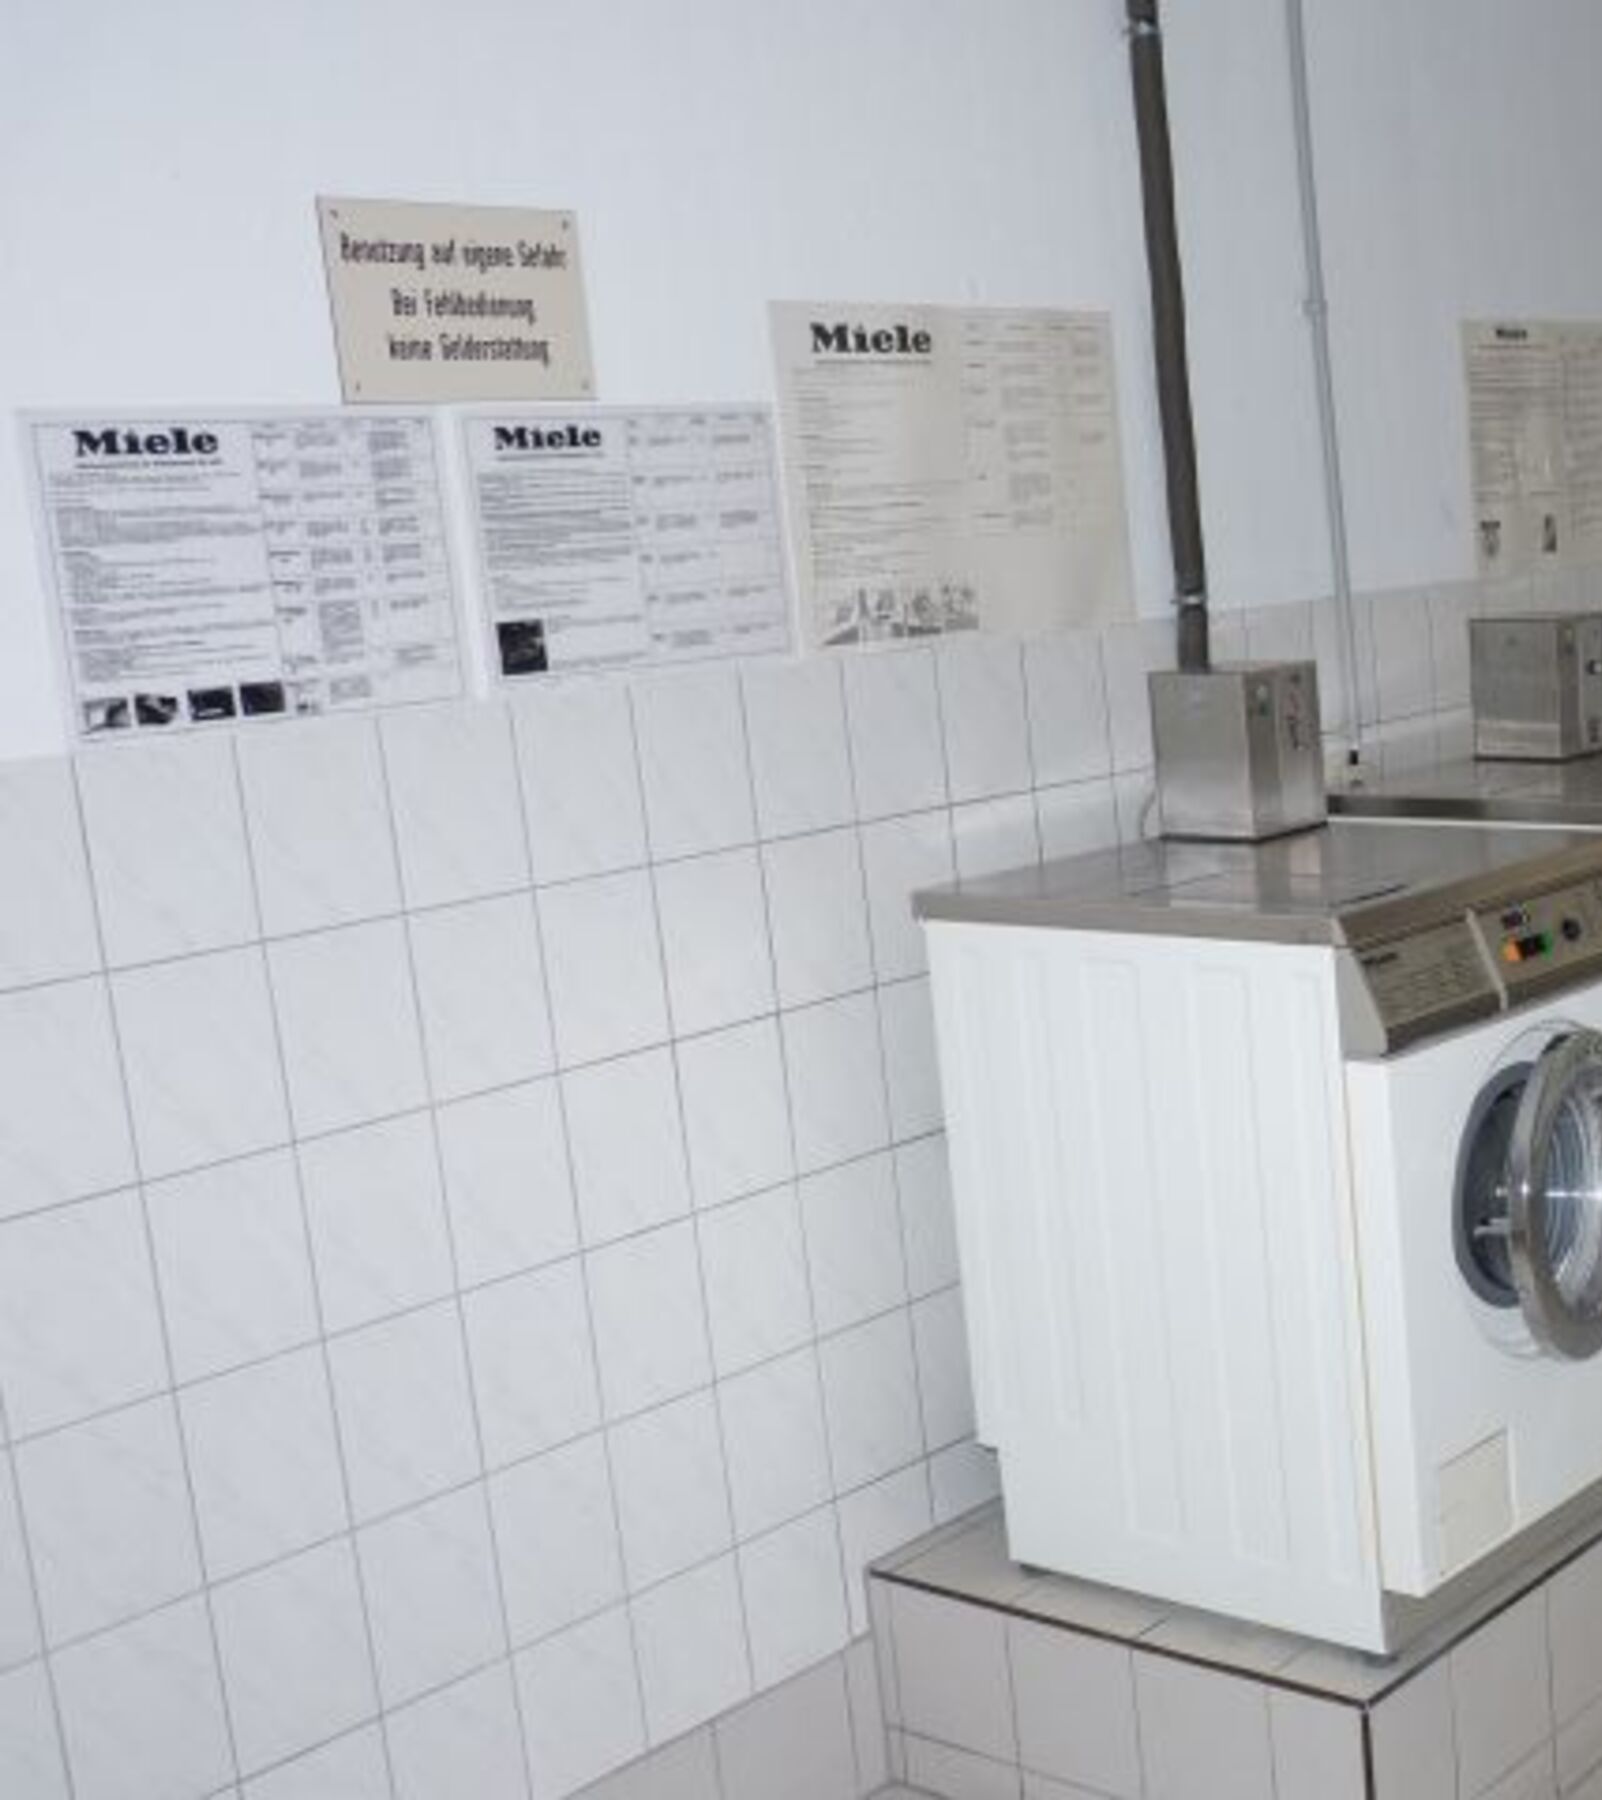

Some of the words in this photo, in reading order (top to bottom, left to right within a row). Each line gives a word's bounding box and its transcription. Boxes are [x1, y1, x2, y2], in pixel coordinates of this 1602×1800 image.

[431, 239, 455, 264] auf
[390, 287, 417, 317] Bei
[809, 321, 932, 354] Miele
[72, 427, 219, 457] Miele
[493, 424, 602, 451] Miele
